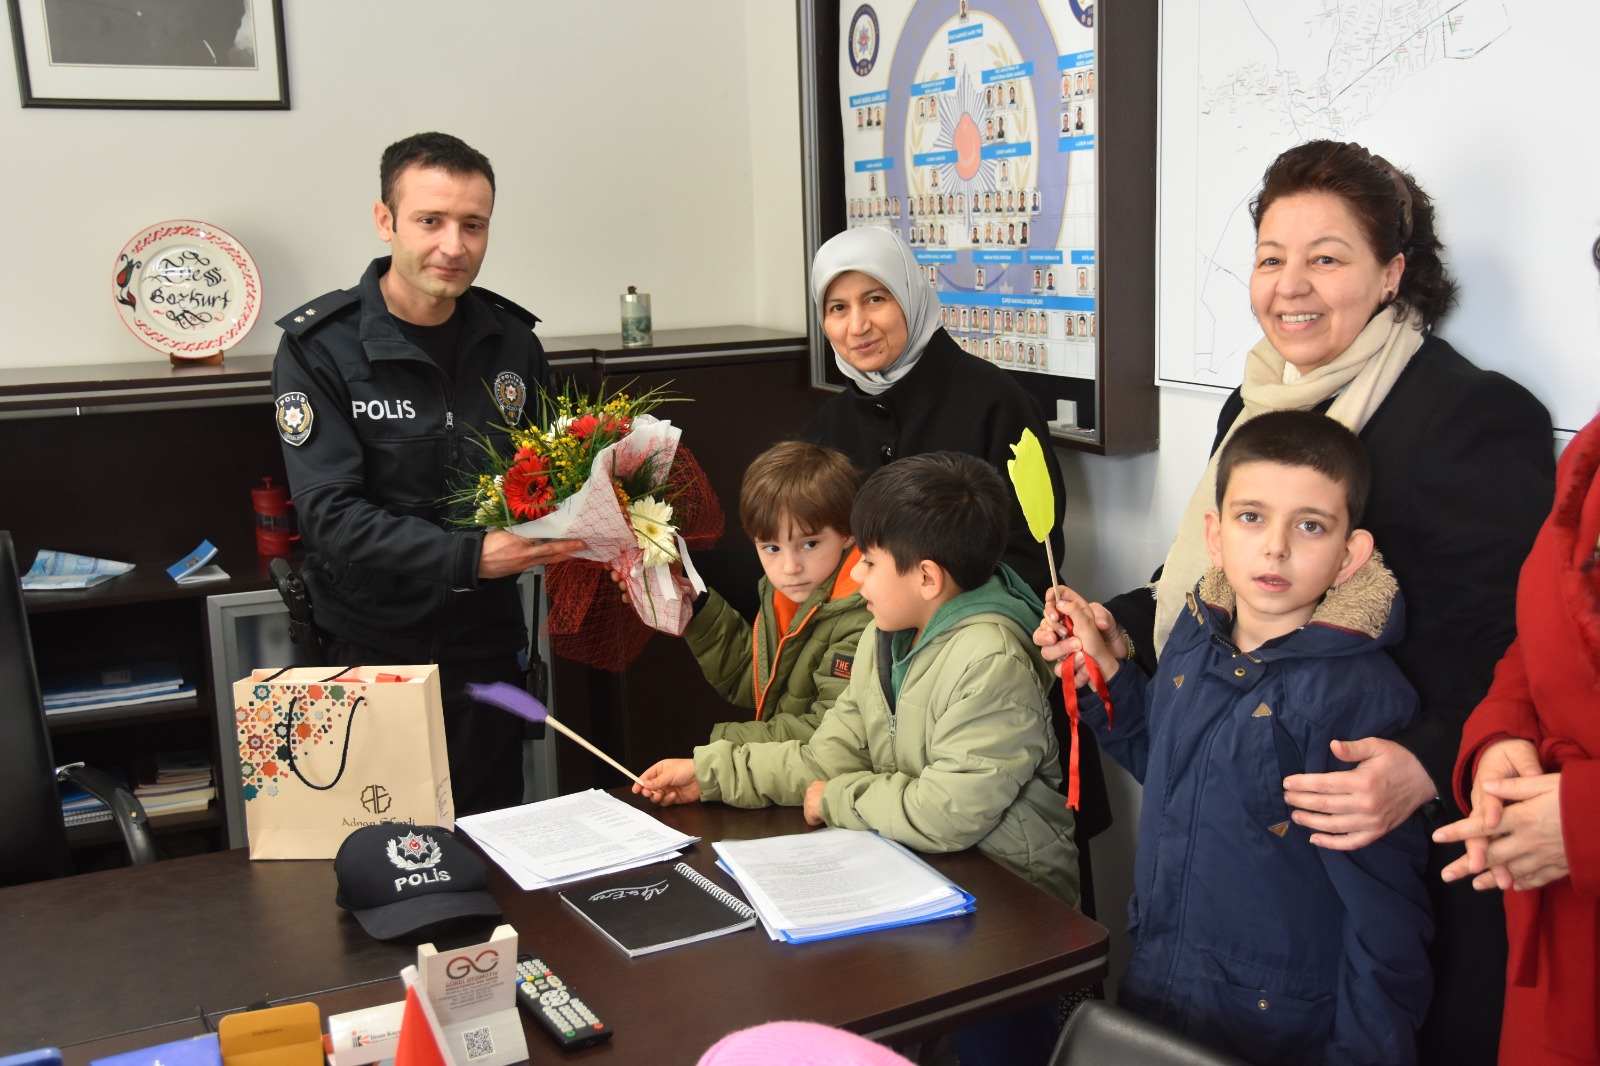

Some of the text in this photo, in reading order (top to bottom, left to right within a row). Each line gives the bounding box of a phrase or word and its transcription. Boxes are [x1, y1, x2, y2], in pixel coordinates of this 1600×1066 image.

[279, 394, 306, 406] POLİS
[351, 399, 417, 420] POLİS
[835, 659, 850, 671] THE
[394, 867, 452, 892] POLİS
